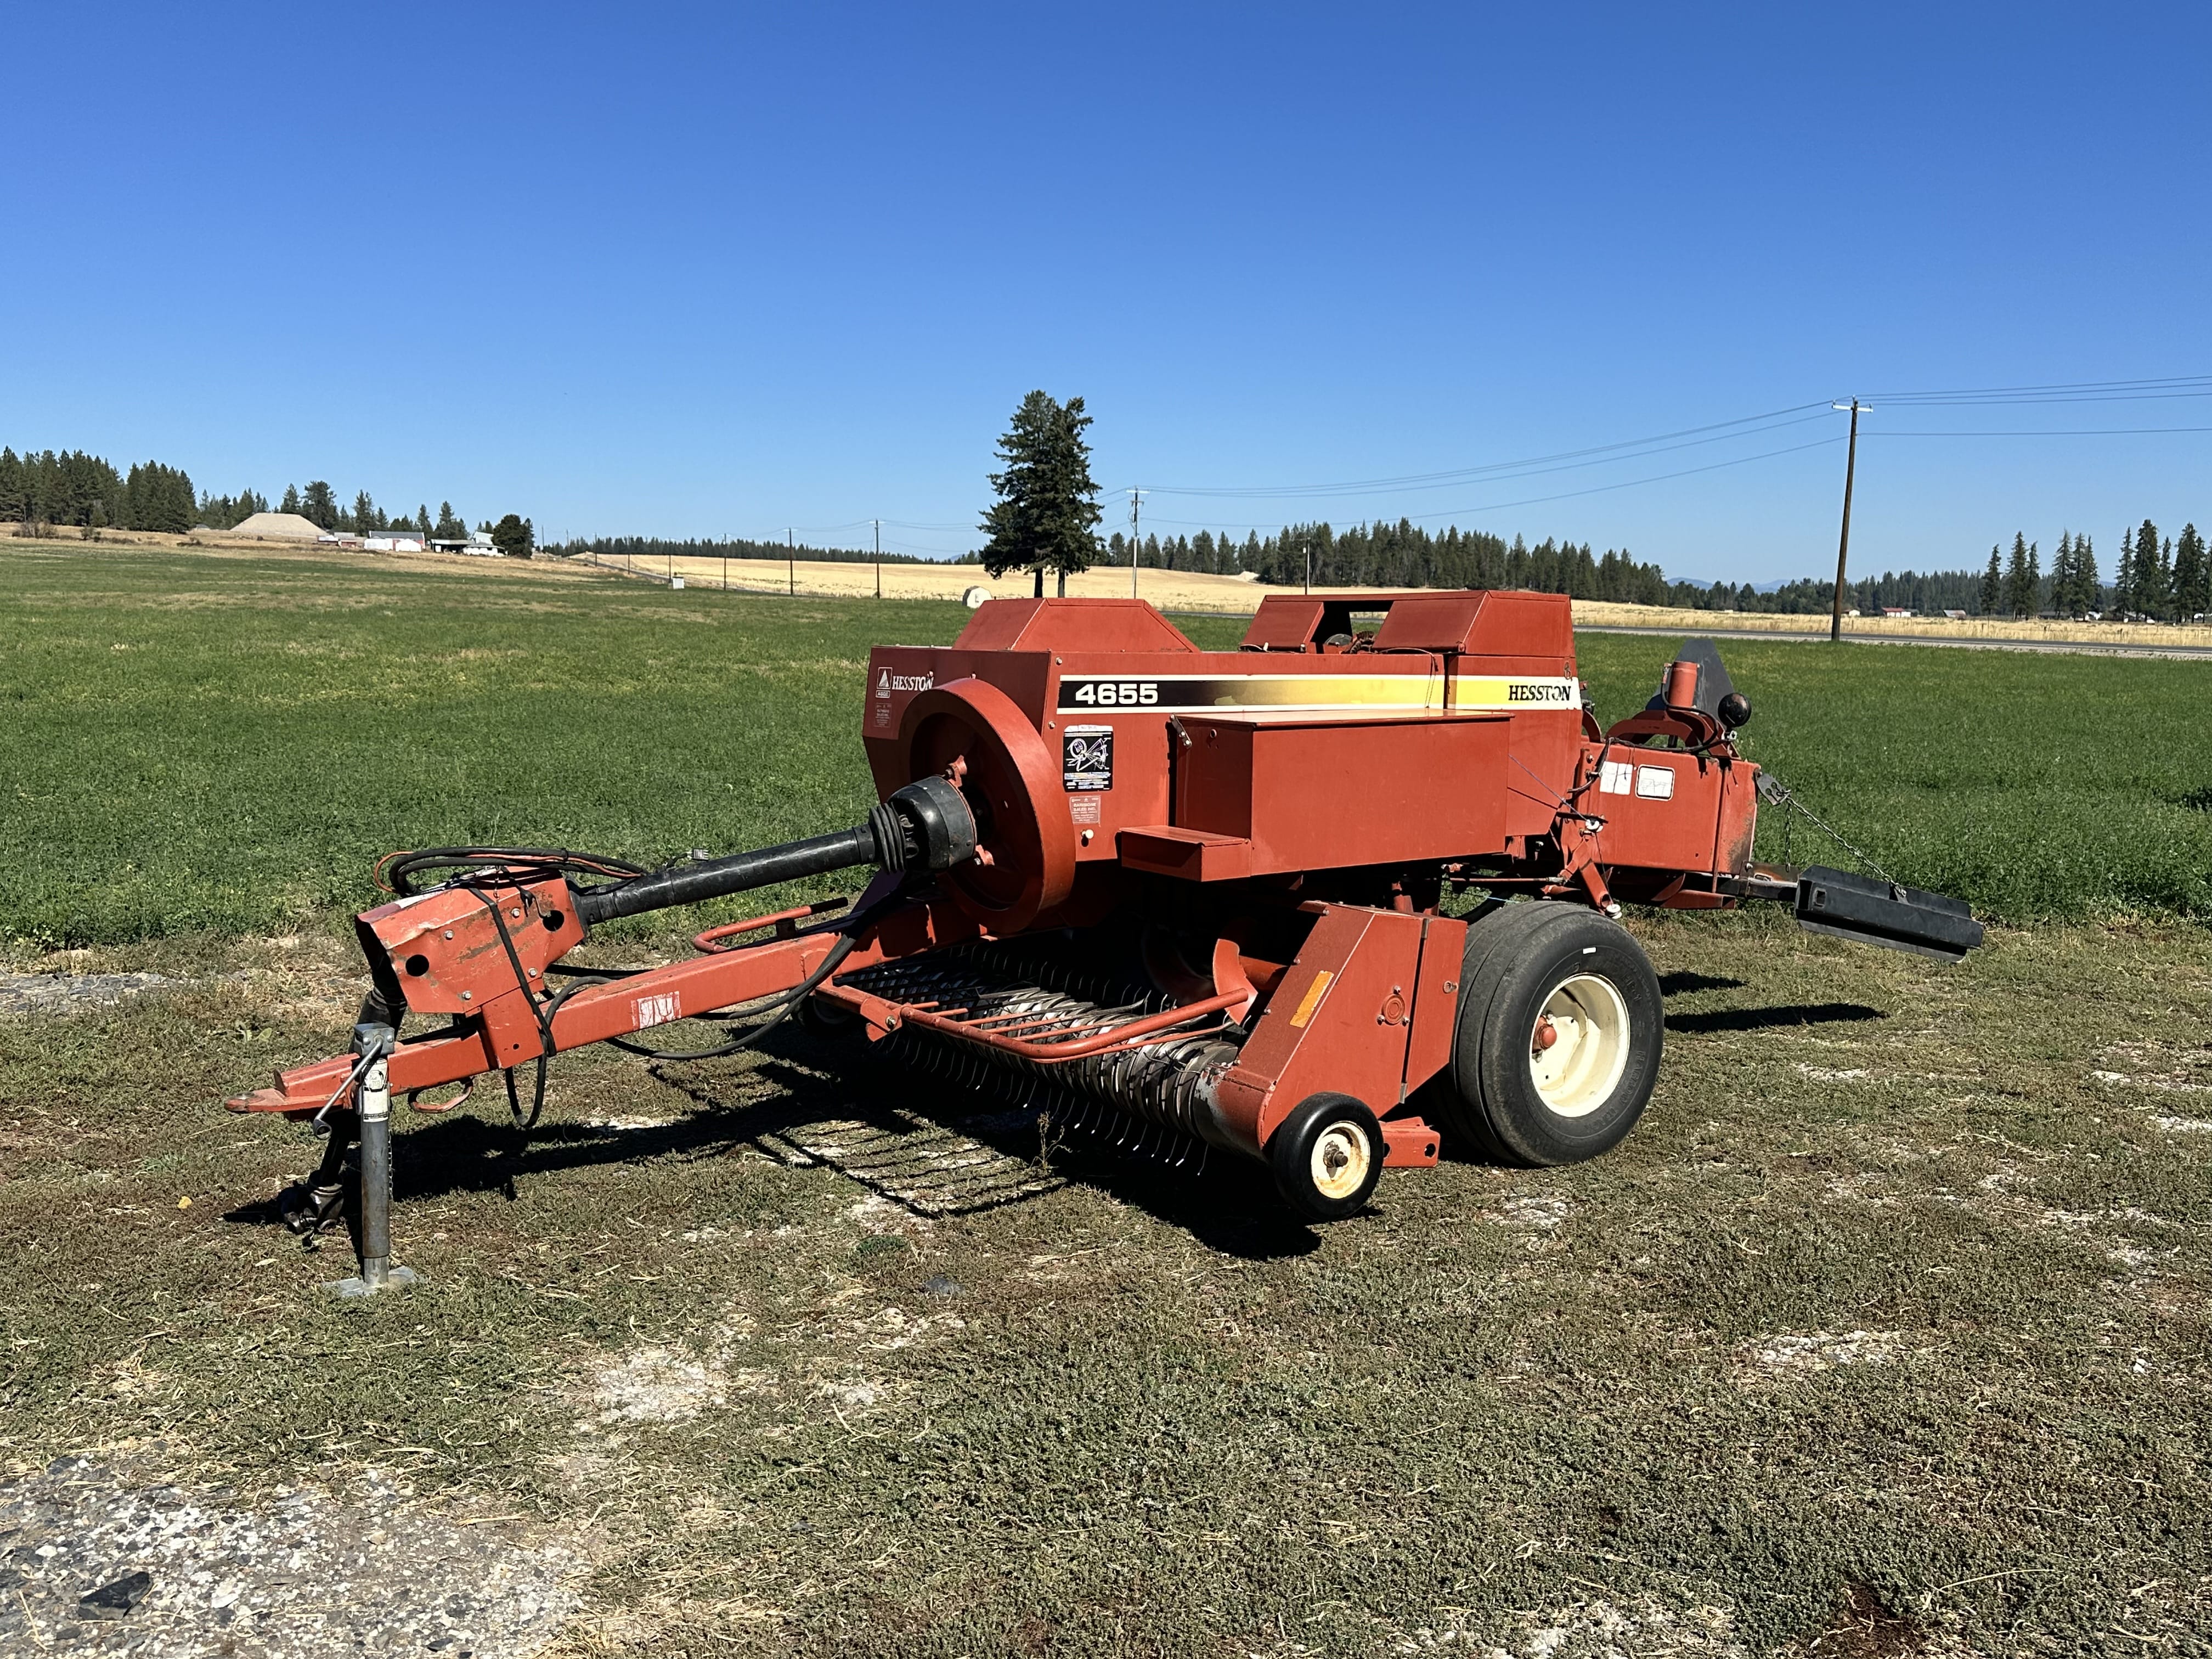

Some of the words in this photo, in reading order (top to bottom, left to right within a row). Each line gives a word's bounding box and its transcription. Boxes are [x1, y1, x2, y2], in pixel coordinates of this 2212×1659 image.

[891, 675, 934, 691] HESSTON
[1076, 684, 1158, 704] 4655
[1508, 685, 1571, 701] HESSTON
